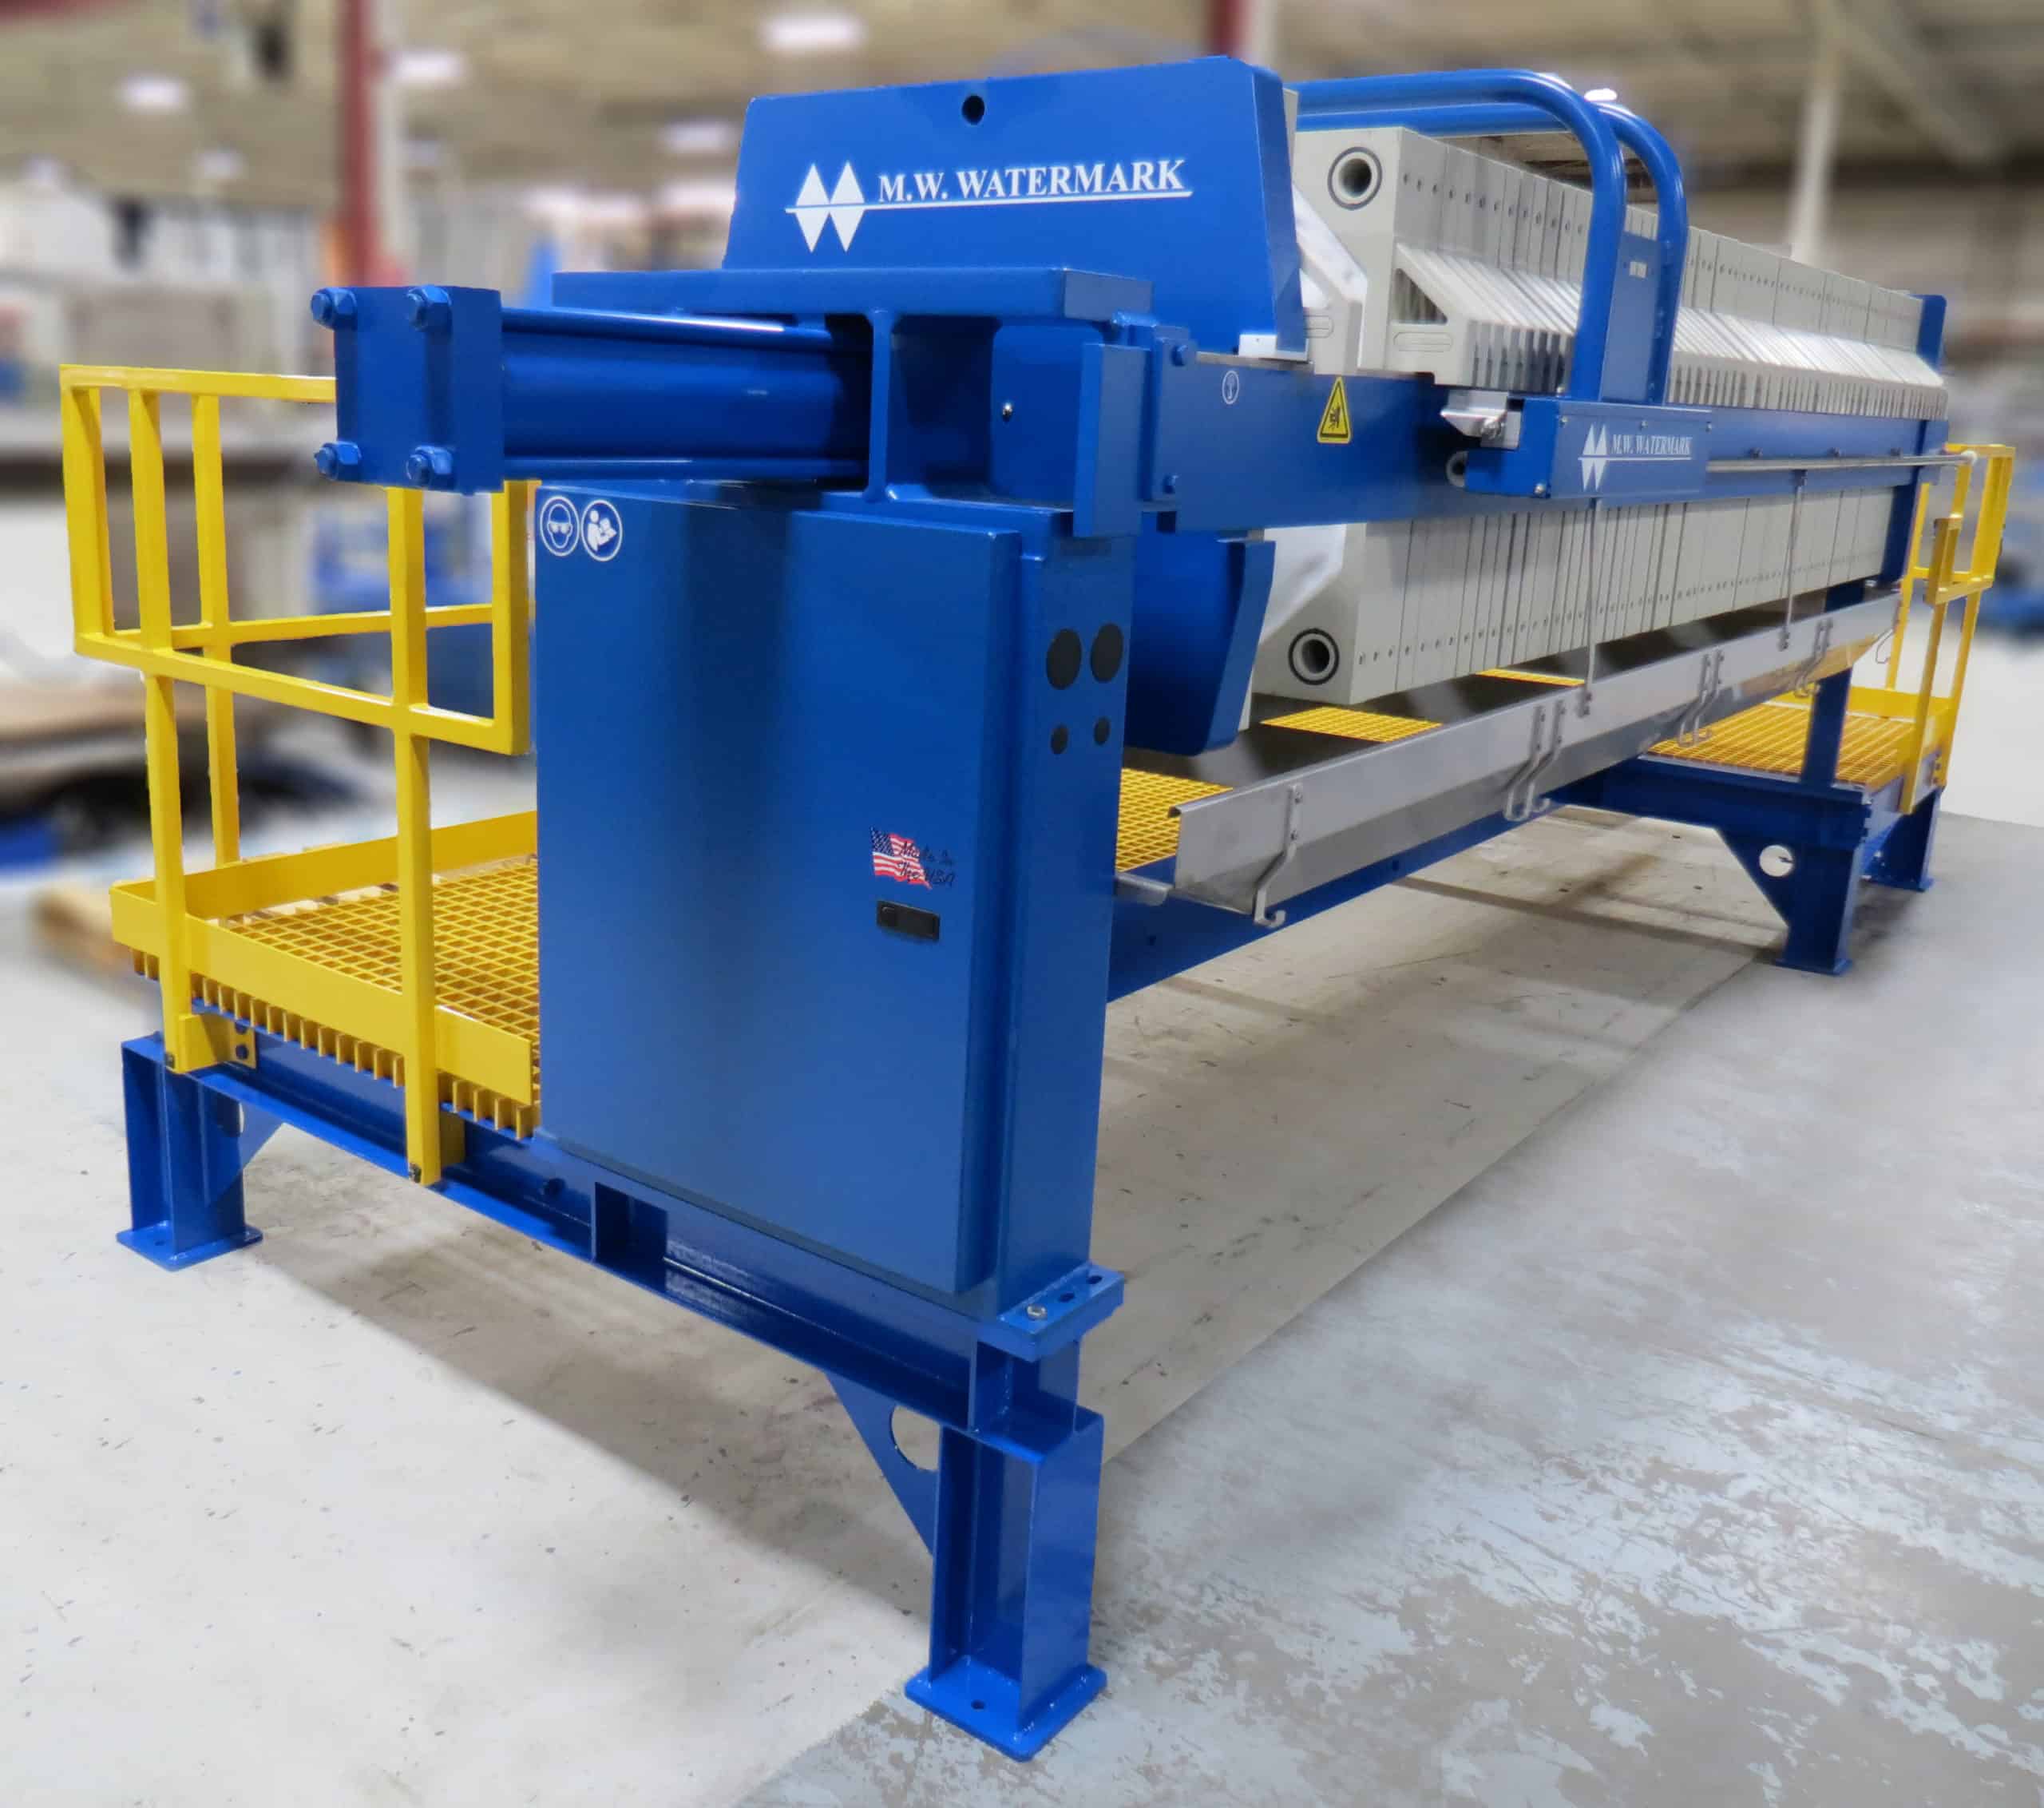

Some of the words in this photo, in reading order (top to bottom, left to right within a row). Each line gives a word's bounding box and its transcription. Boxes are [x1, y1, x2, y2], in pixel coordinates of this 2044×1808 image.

[879, 173, 947, 202] M.W.
[957, 160, 1186, 198] WATERMARK
[1611, 434, 1634, 455] M.W.
[1636, 435, 1693, 455] WATERMARK
